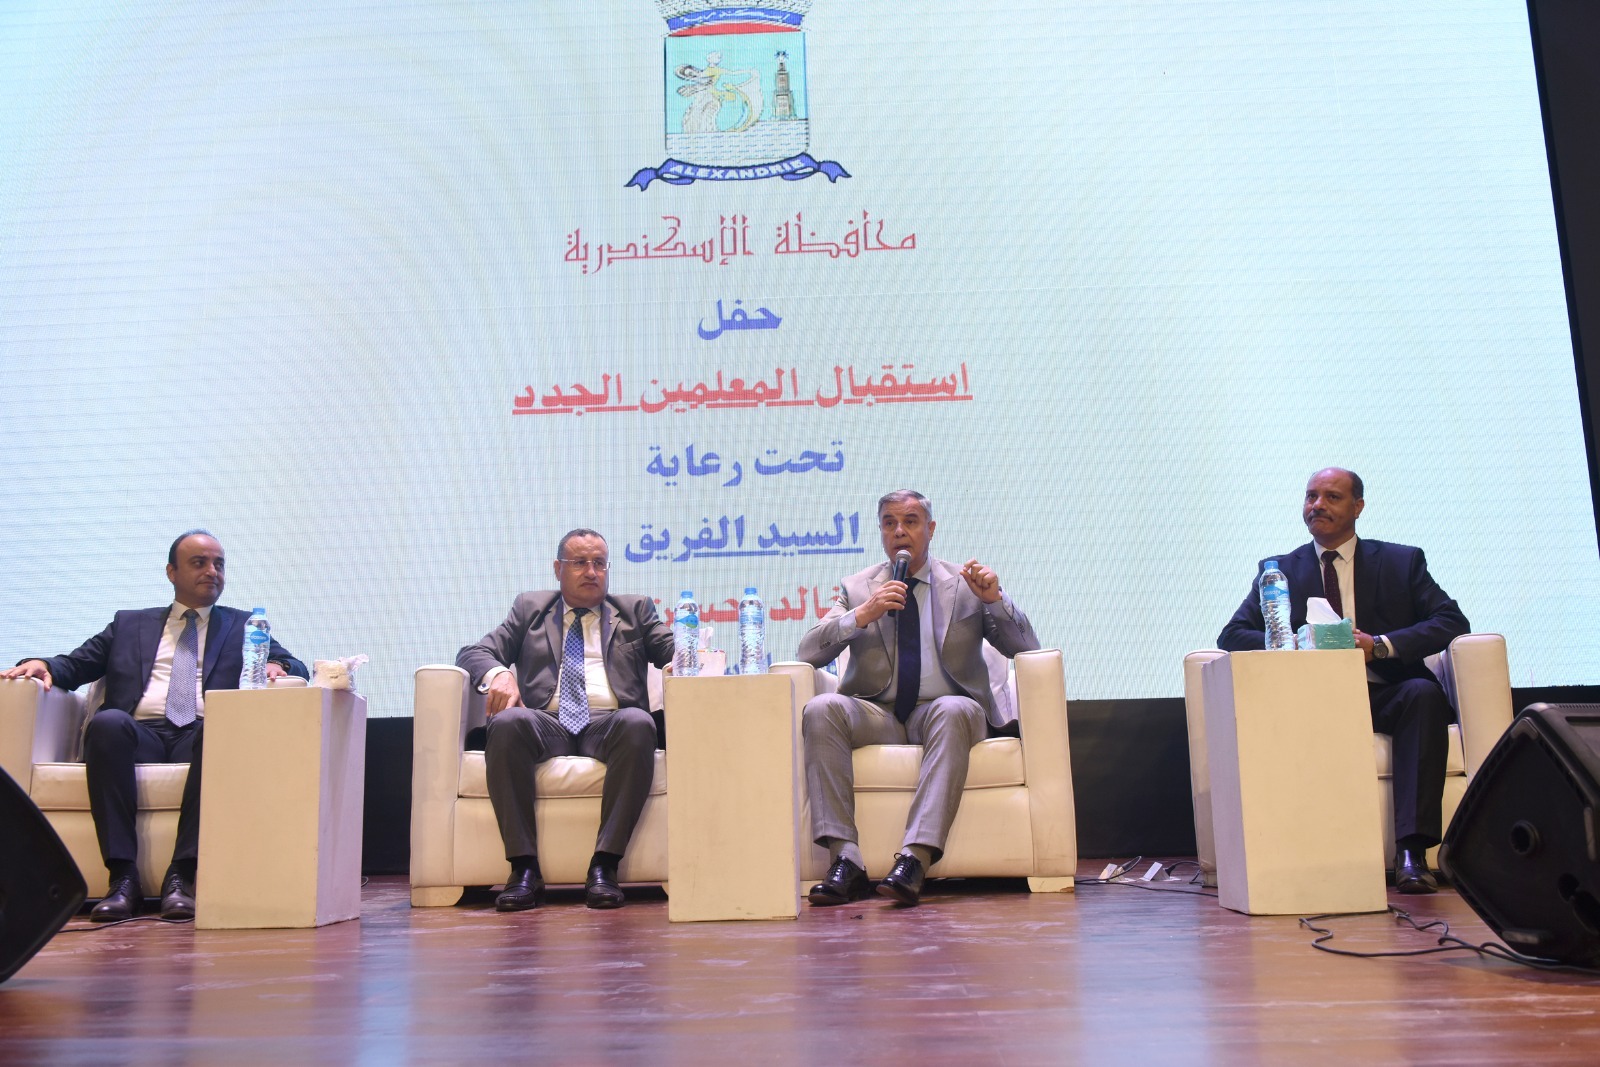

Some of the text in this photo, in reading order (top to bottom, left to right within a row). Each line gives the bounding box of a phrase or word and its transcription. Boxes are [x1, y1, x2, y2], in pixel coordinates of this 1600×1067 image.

[669, 159, 805, 179] ALEXANDRIE
[564, 210, 916, 274] محافظة الإسكندرية
[697, 299, 782, 340] حفل
[513, 363, 970, 416] استقبال المعلمين الجدد
[646, 440, 844, 487] تحت رعاية
[624, 512, 860, 562] السيد الفريق
